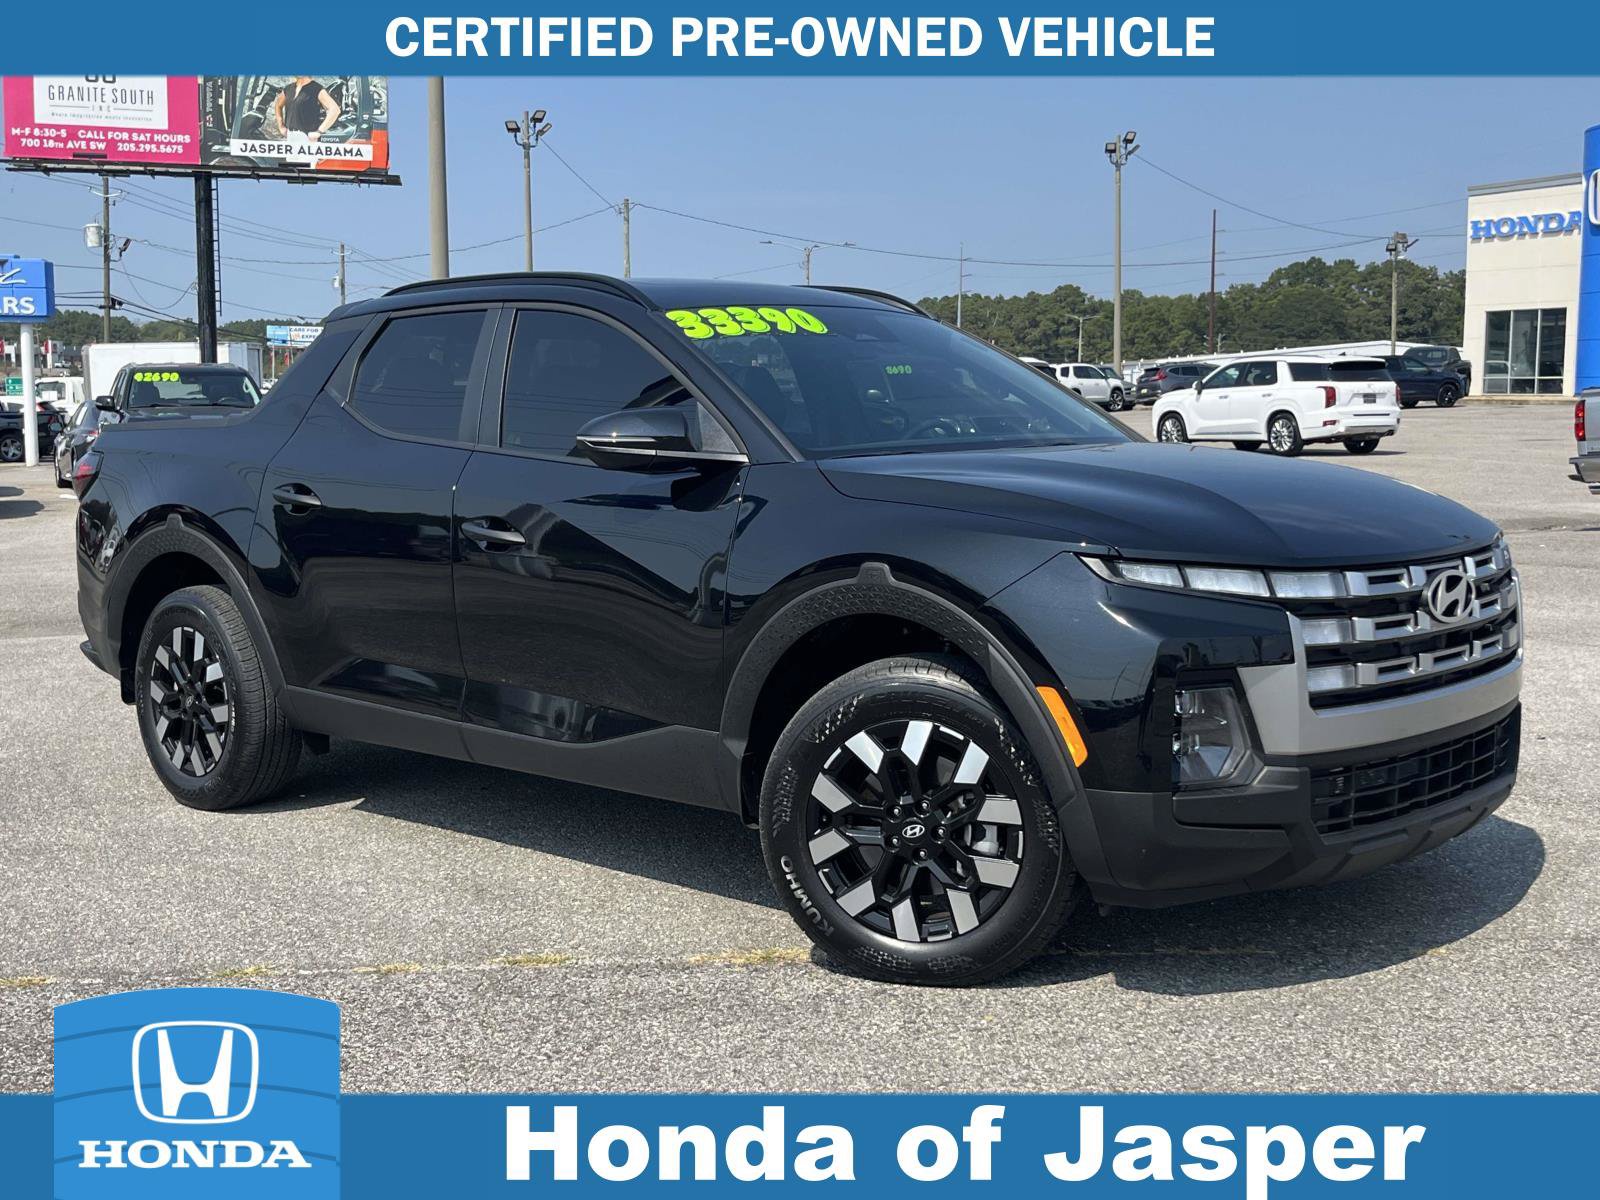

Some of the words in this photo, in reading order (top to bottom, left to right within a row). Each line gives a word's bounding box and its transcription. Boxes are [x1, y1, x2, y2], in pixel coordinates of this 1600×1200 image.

[48, 85, 106, 103] GRANITE
[112, 87, 154, 105] SOUTH
[11, 127, 31, 136] M-F
[78, 129, 105, 139] CALL
[107, 131, 129, 140] FOR
[132, 132, 151, 141] SAT
[154, 133, 191, 143] HOURS
[21, 138, 40, 147] 700
[66, 140, 87, 149] AVE
[89, 141, 107, 150] SW
[117, 142, 184, 154] 205.295.5675
[239, 142, 293, 155] JASPER
[297, 144, 364, 158] ALABAMA
[1470, 210, 1582, 240] HONDA
[0, 296, 35, 315] RS
[665, 305, 828, 339] 33390
[780, 855, 834, 936] KUMHO
